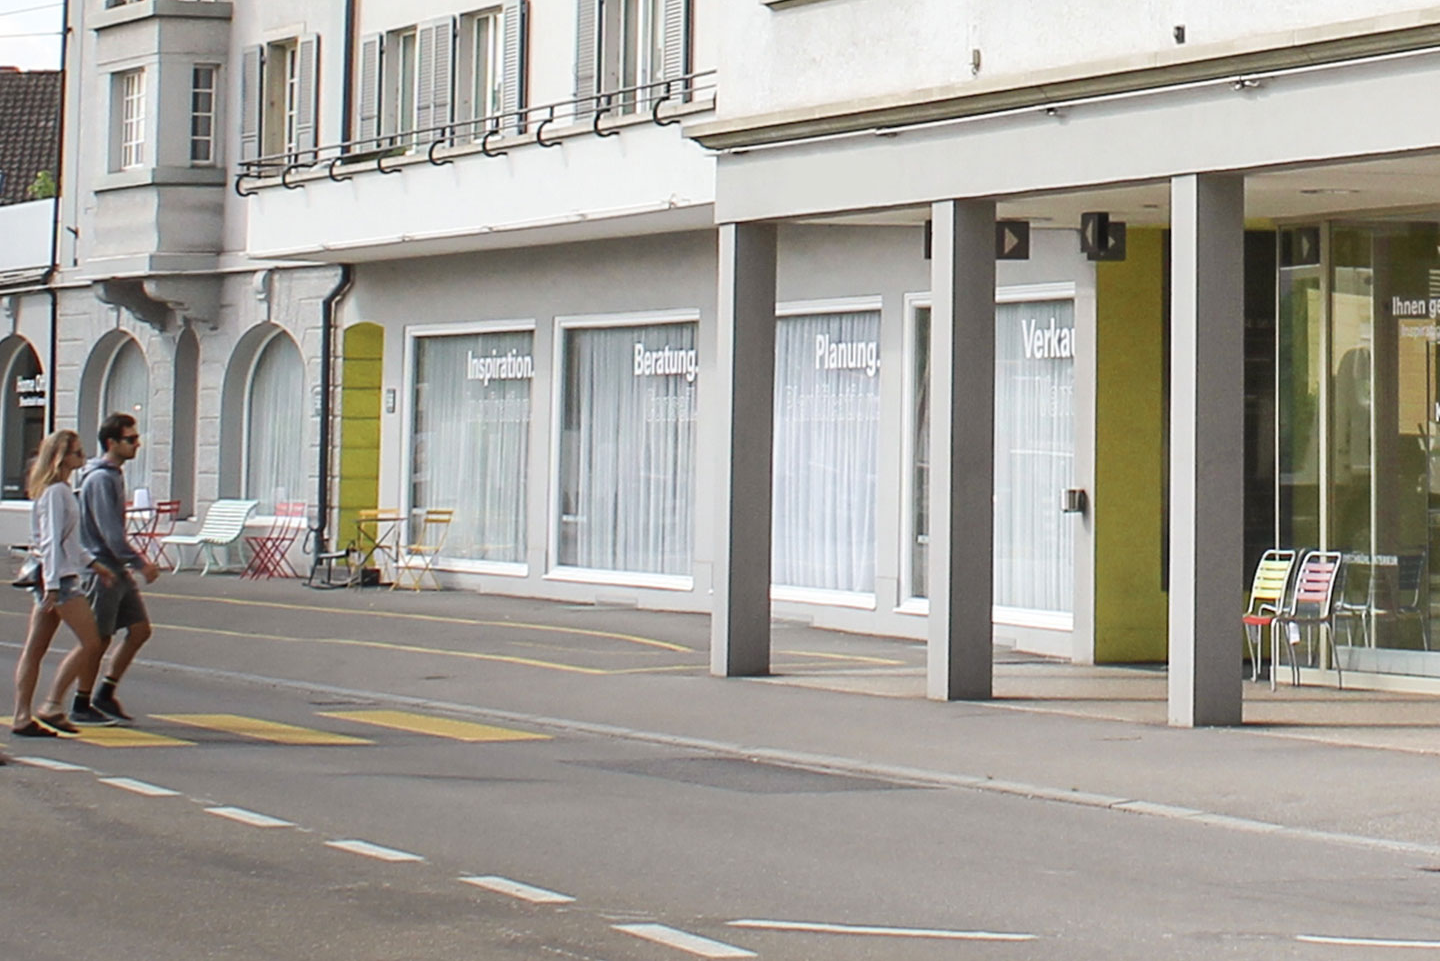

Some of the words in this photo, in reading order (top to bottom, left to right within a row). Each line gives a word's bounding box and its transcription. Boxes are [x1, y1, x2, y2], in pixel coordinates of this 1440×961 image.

[1392, 295, 1426, 316] Ihnen
[467, 348, 535, 386] Inspiration.
[634, 343, 699, 382] Beratung.
[815, 333, 880, 377] Planung.
